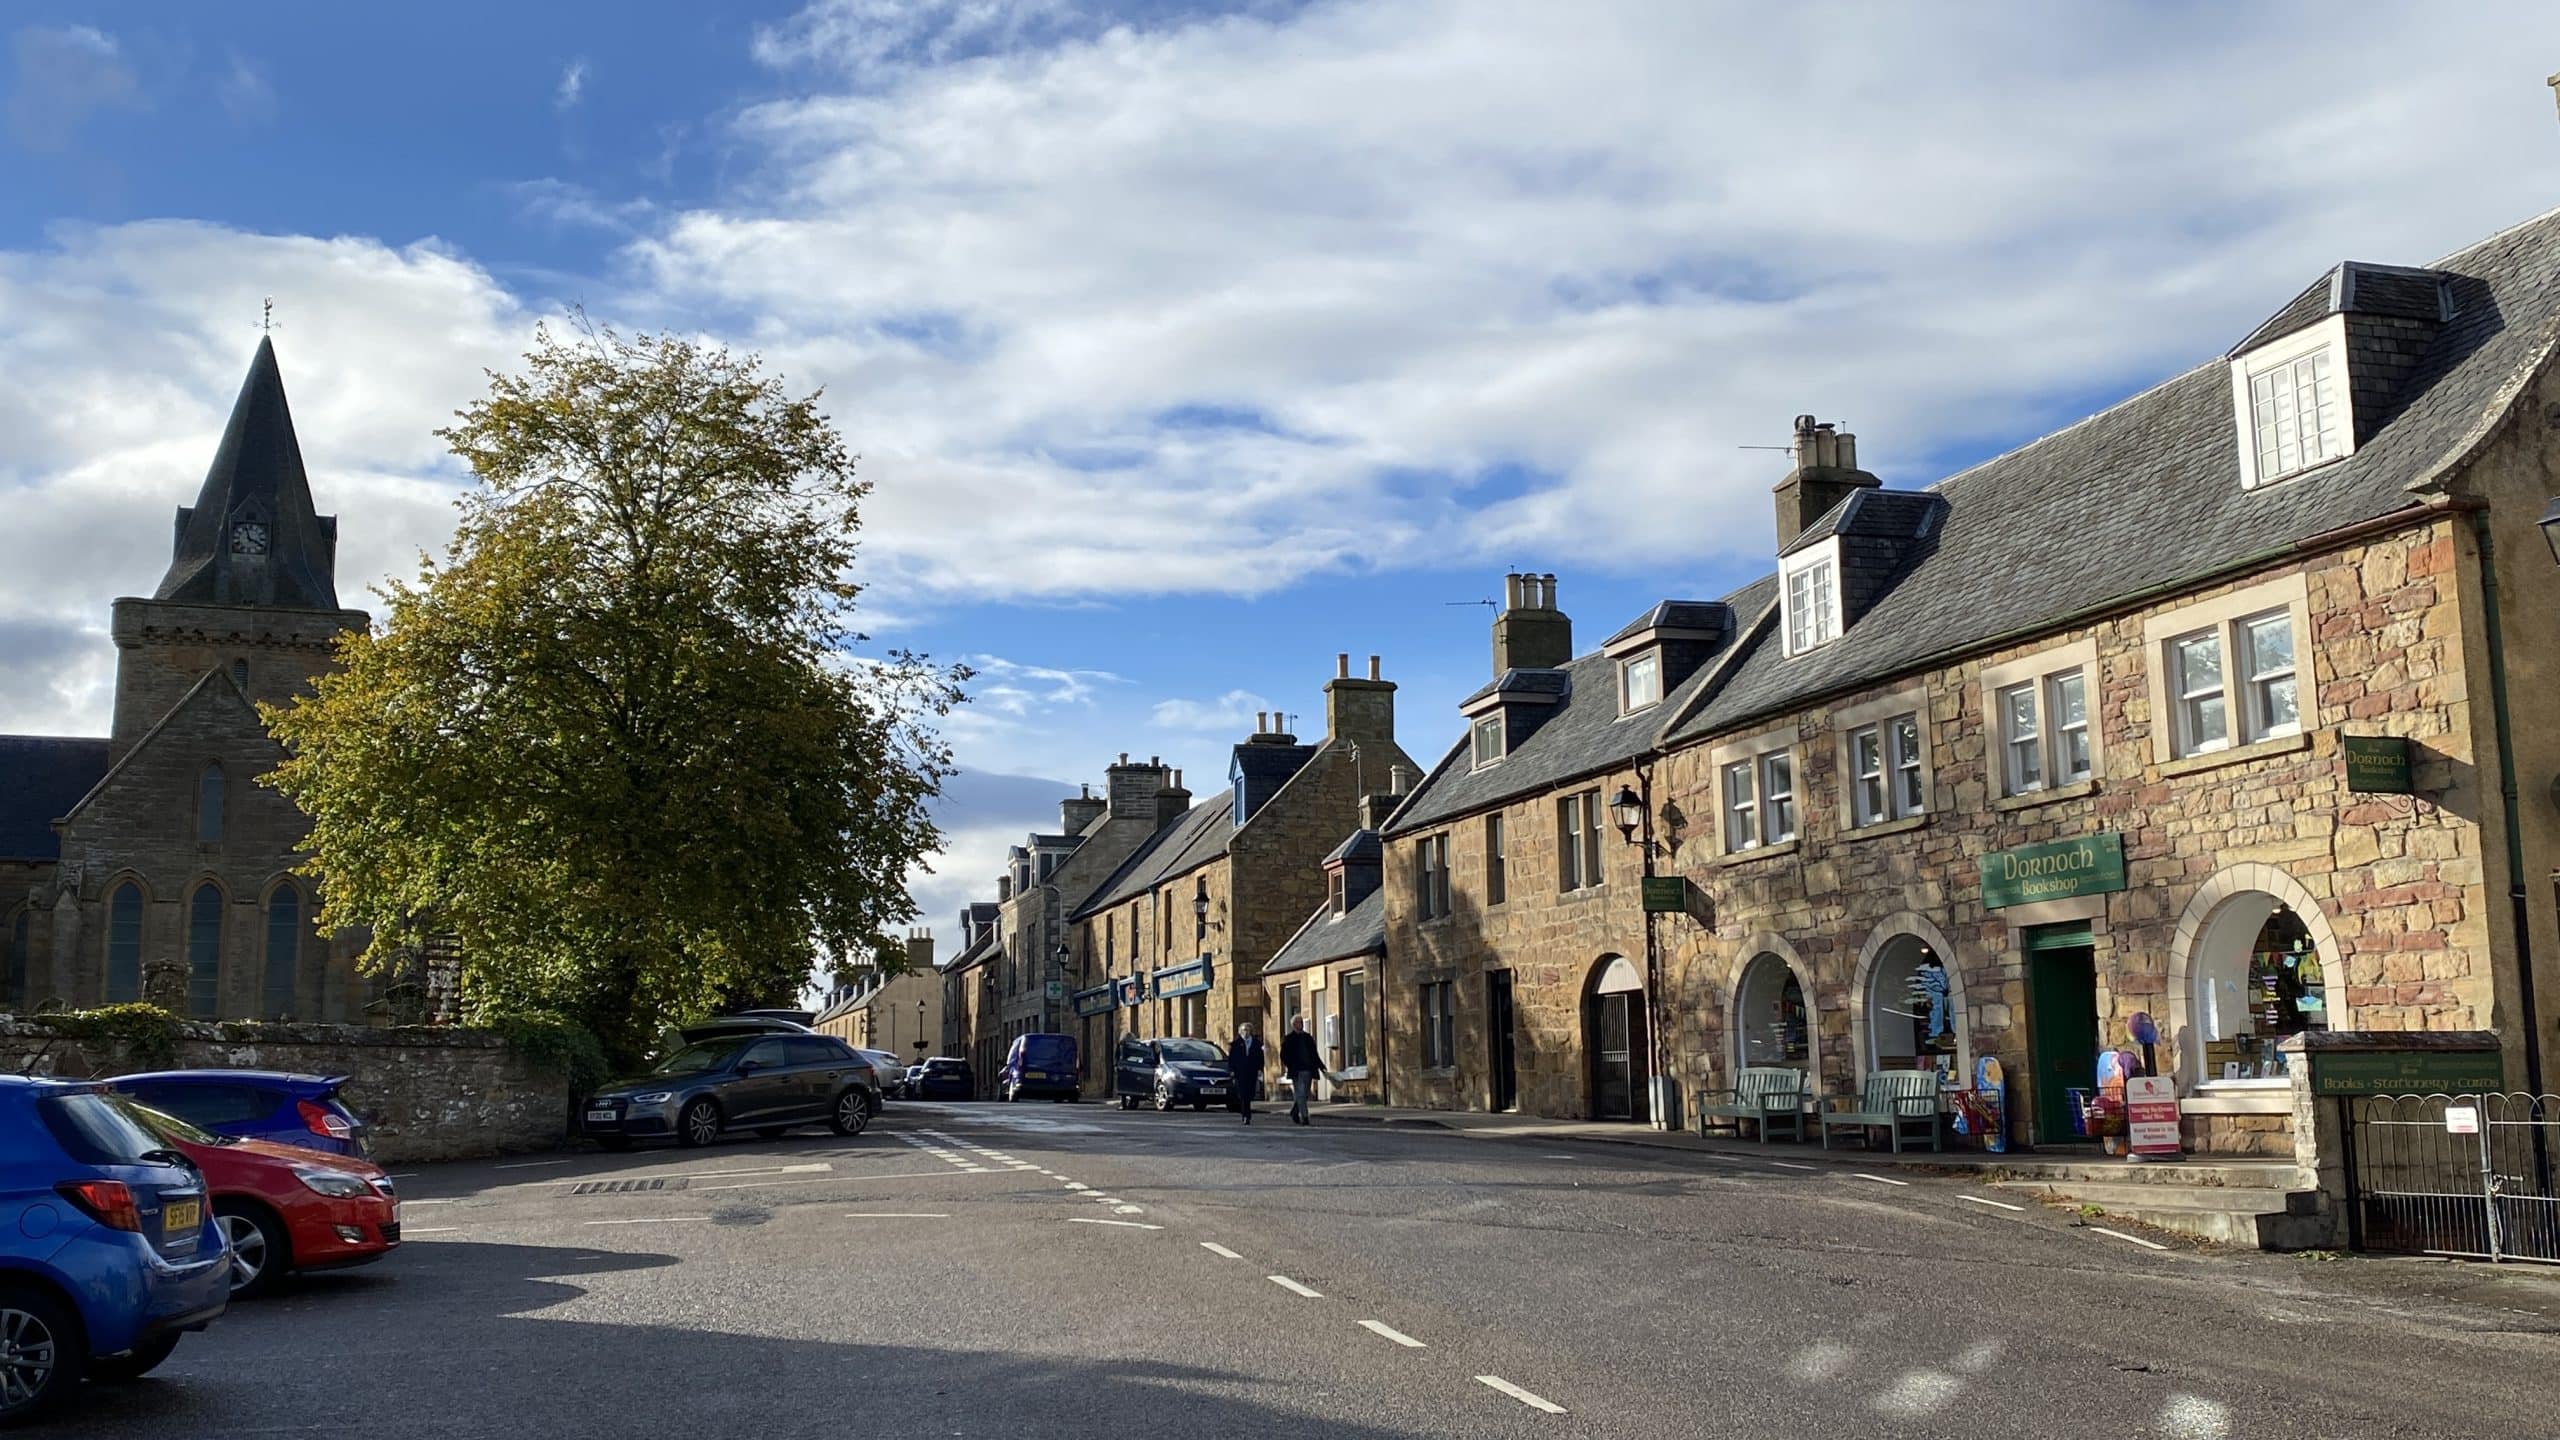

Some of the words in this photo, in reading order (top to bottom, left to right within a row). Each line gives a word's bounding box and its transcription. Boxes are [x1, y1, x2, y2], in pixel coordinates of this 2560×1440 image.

[2347, 750, 2406, 766] Dornoch
[2003, 843, 2095, 881] Dornoch
[2021, 876, 2078, 897] Bookshop
[2323, 1077, 2365, 1089] Books
[2373, 1077, 2450, 1090] Stationery
[2457, 1077, 2499, 1089] Cards
